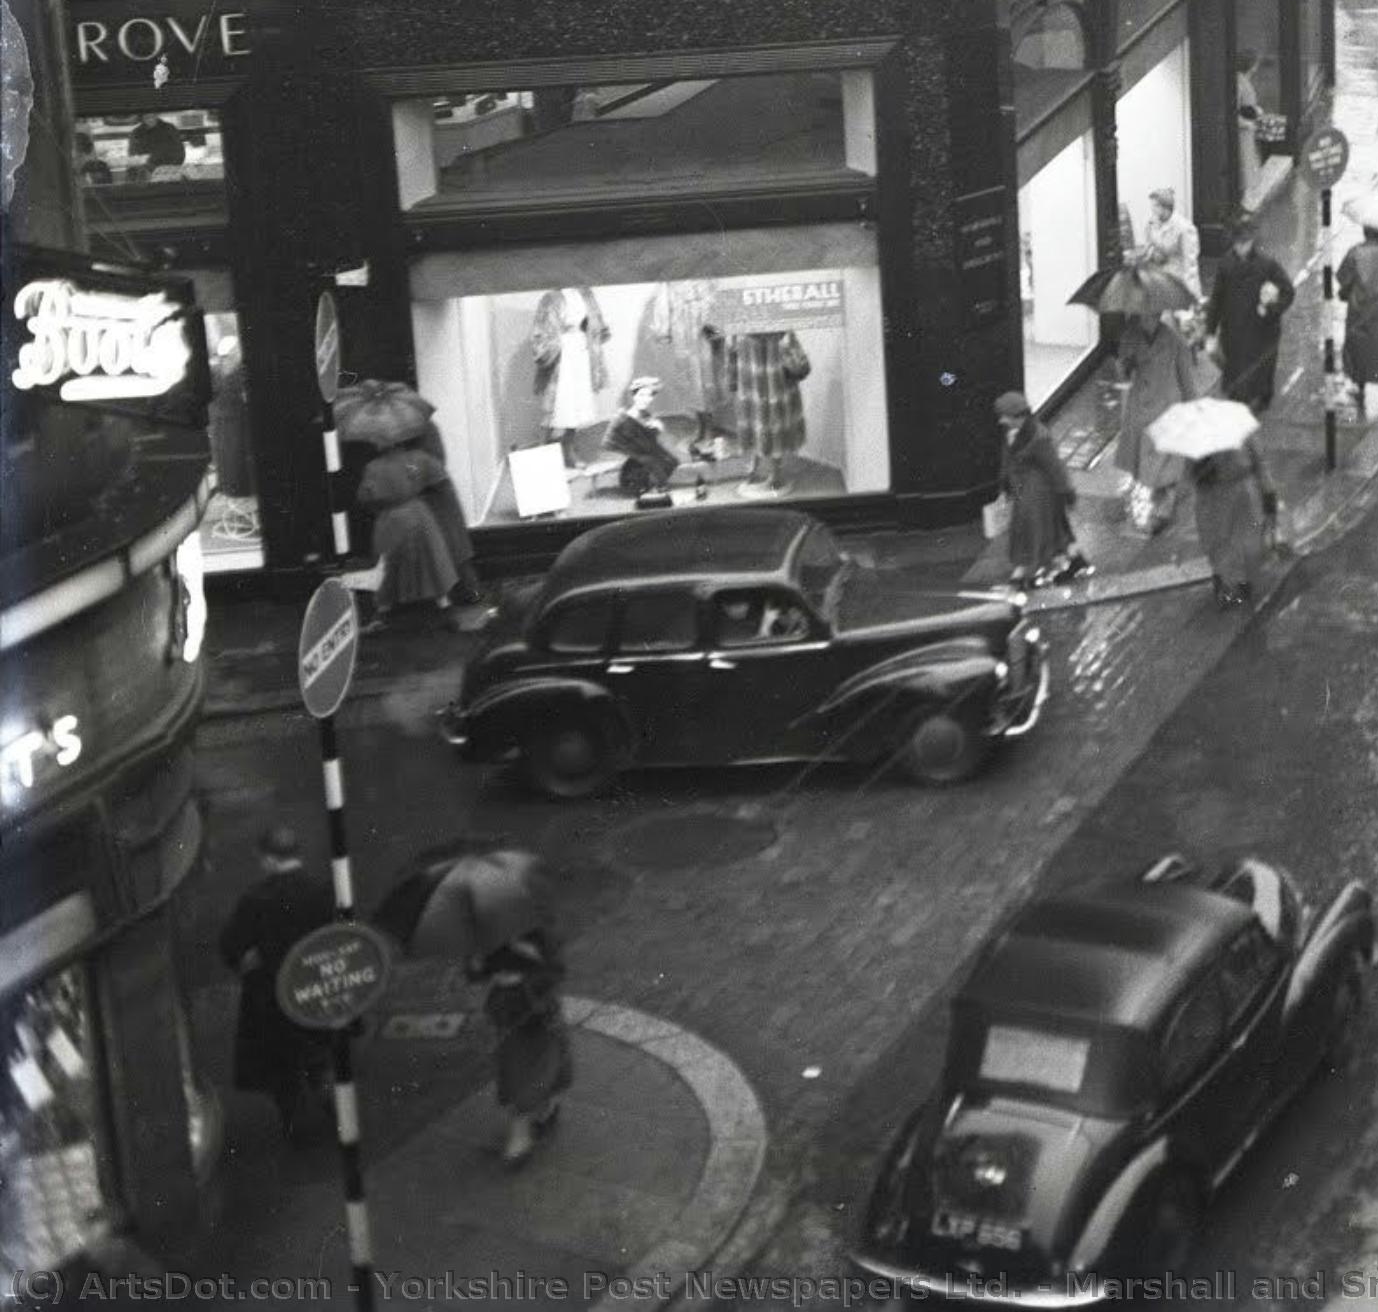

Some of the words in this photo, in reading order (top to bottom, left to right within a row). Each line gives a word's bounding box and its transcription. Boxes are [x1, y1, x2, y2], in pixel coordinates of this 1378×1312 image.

[76, 12, 251, 62] ROVE
[293, 965, 377, 1005] WAITING
[319, 958, 347, 977] NO
